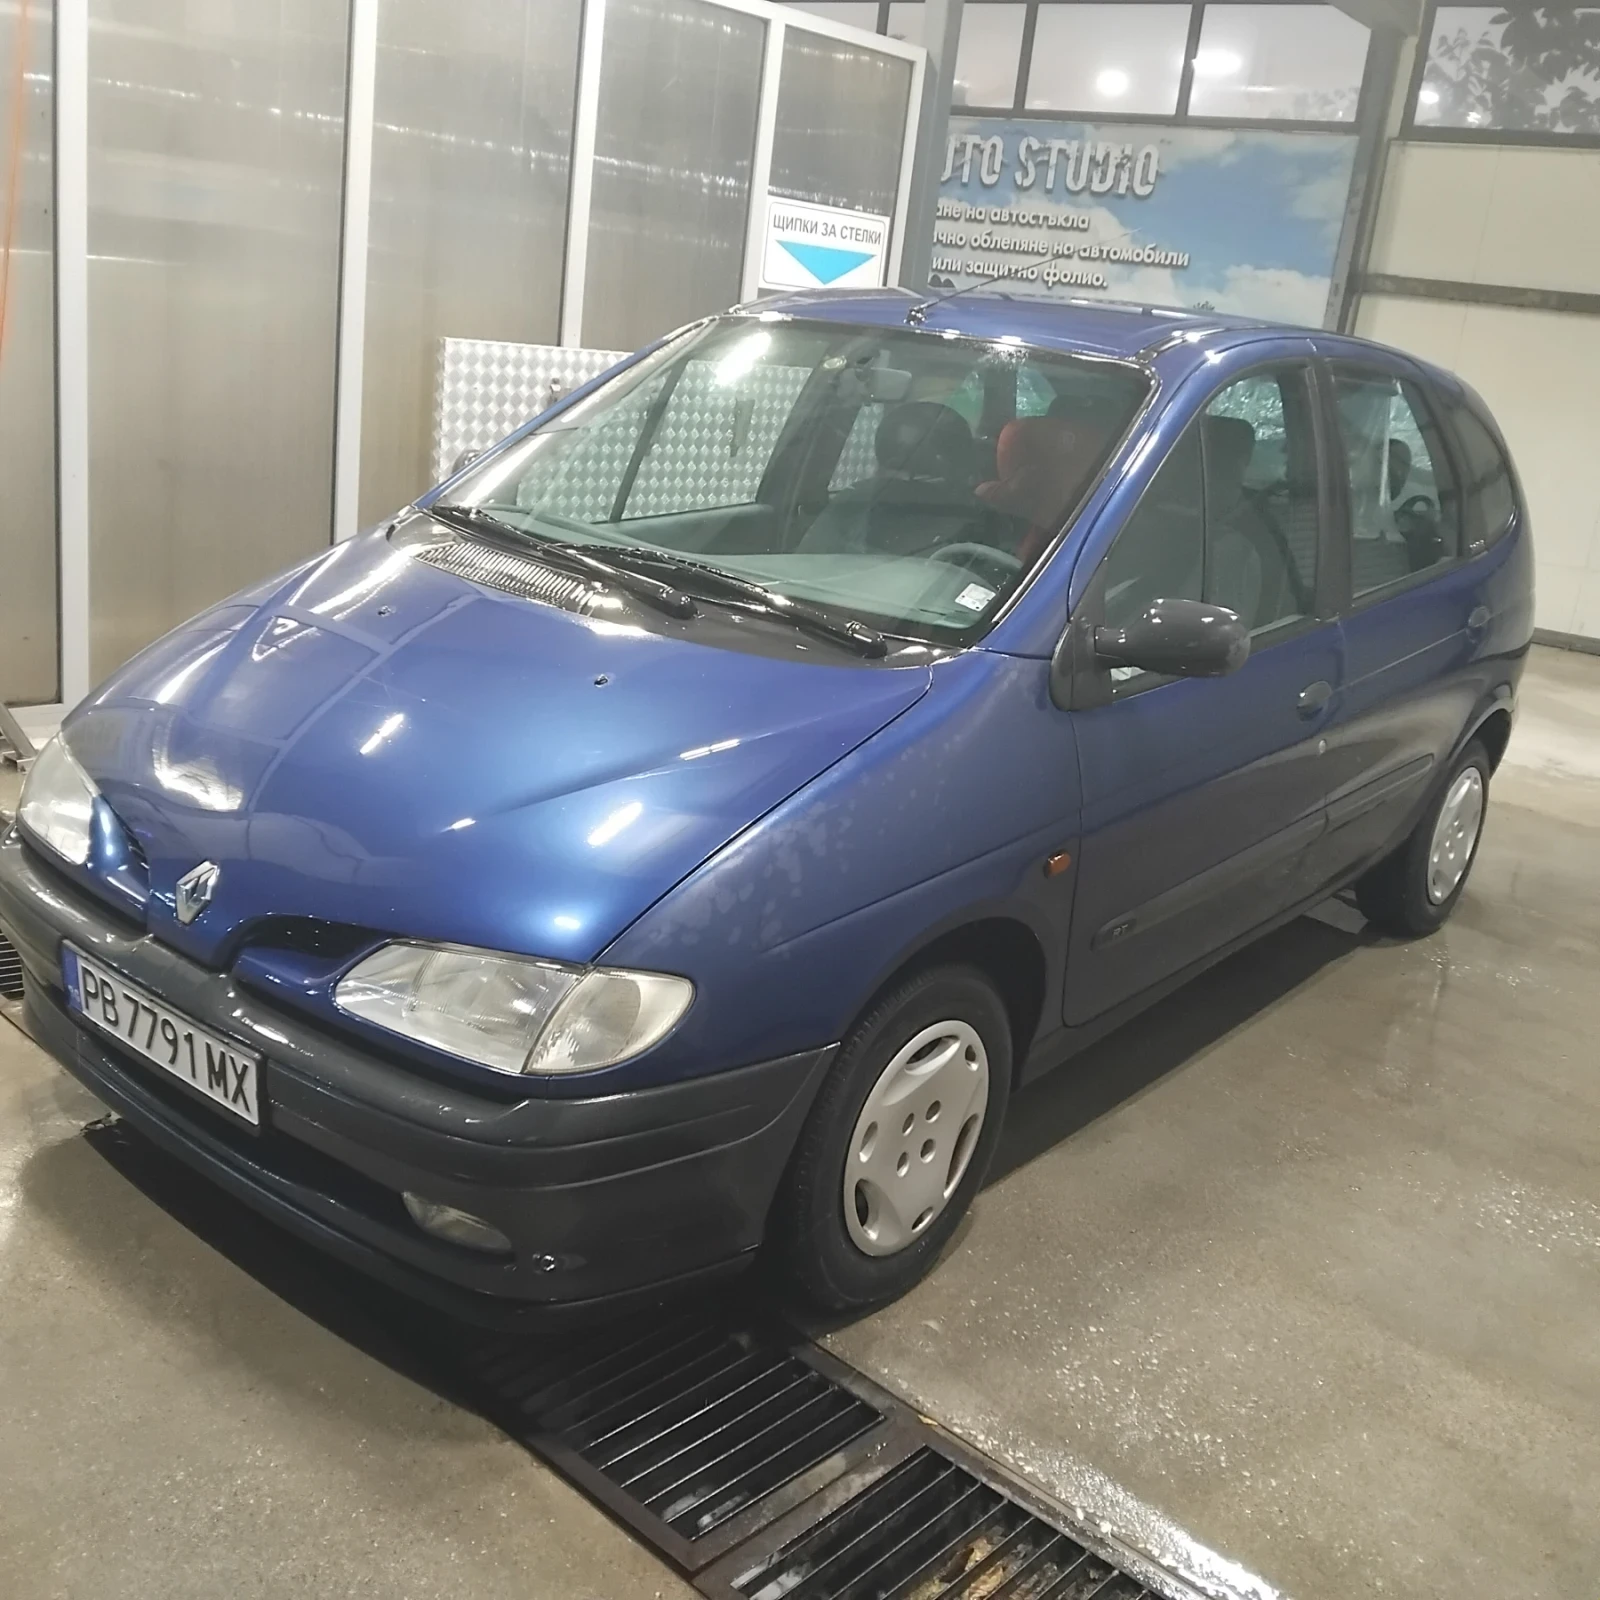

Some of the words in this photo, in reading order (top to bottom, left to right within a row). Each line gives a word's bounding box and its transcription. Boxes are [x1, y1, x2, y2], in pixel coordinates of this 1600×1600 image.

[1015, 136, 1160, 197] STUDIO
[773, 213, 818, 235] ЩИПКИ
[821, 221, 837, 238] ЗА
[840, 225, 882, 246] СТЕЛКИ
[966, 206, 986, 221] на
[990, 208, 1090, 230] автостъкла
[970, 229, 1049, 254] облепяне
[1079, 243, 1190, 267] автомобили
[932, 256, 962, 273] или
[966, 260, 1038, 280] защитно
[1043, 260, 1109, 289] фолио.
